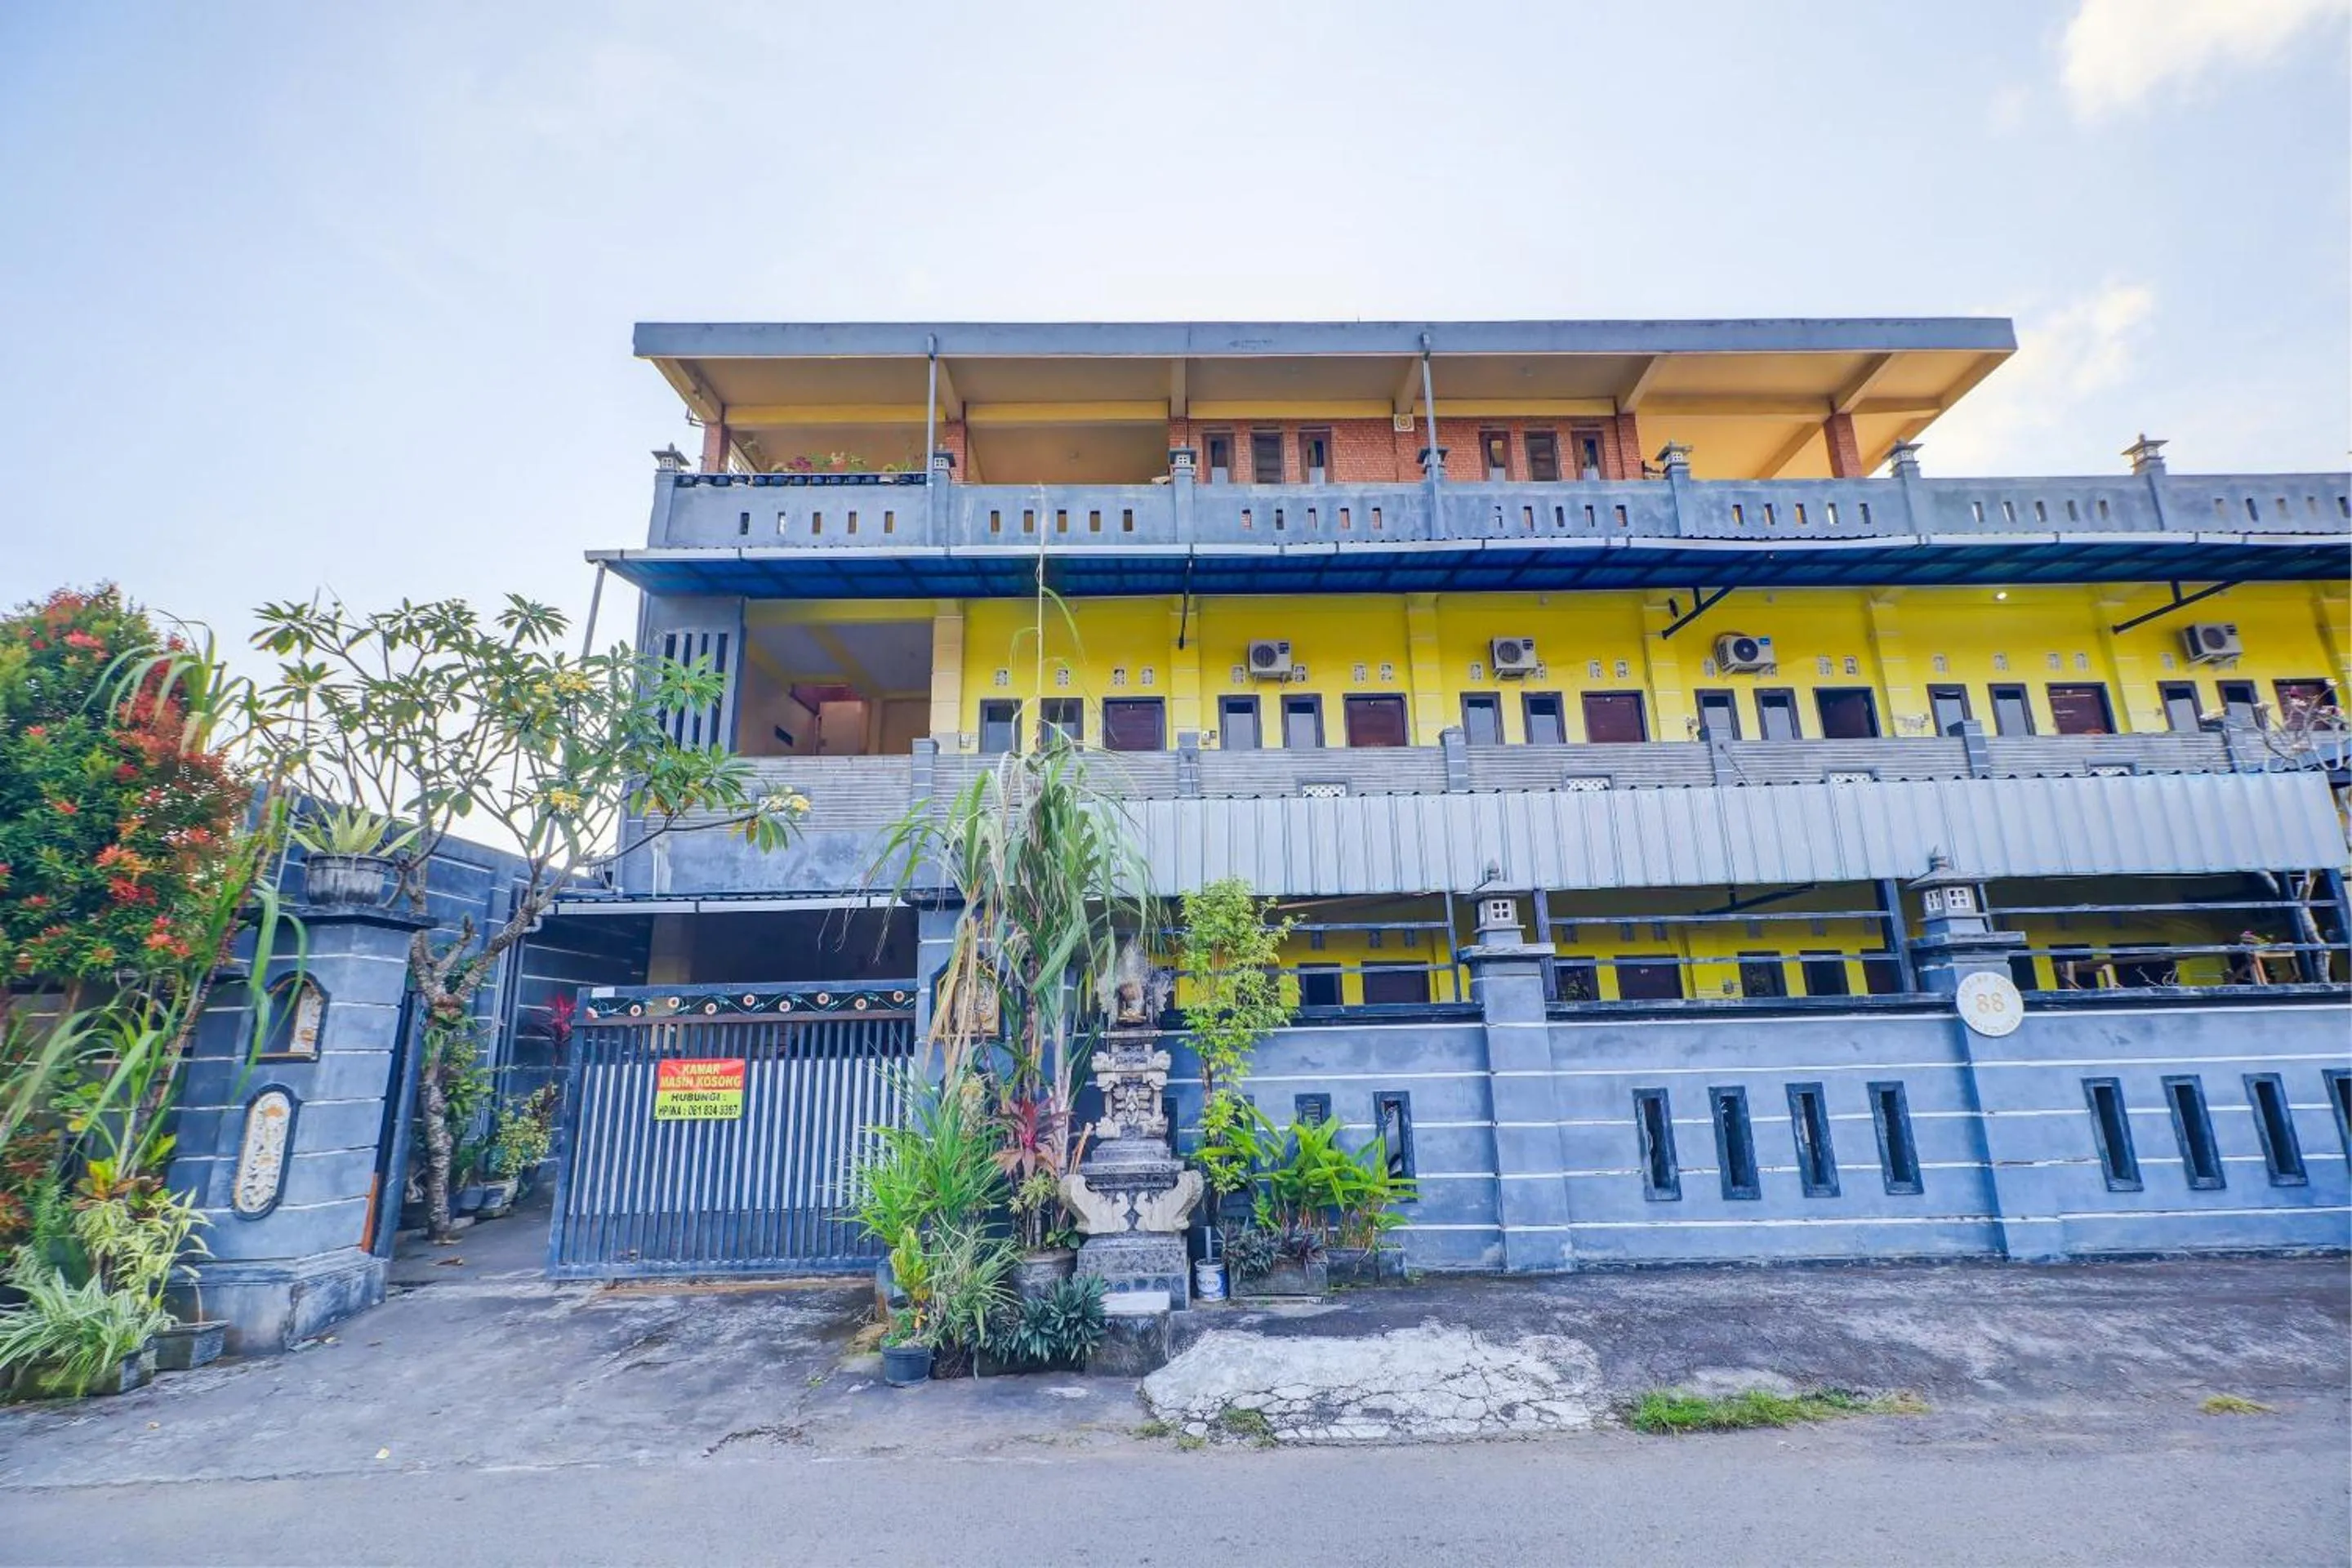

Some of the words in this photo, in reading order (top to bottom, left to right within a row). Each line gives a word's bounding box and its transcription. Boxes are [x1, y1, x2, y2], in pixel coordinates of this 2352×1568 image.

[1976, 992, 2006, 1013] 88
[683, 1063, 721, 1075] KAMAR
[697, 1076, 742, 1087] KOSONG
